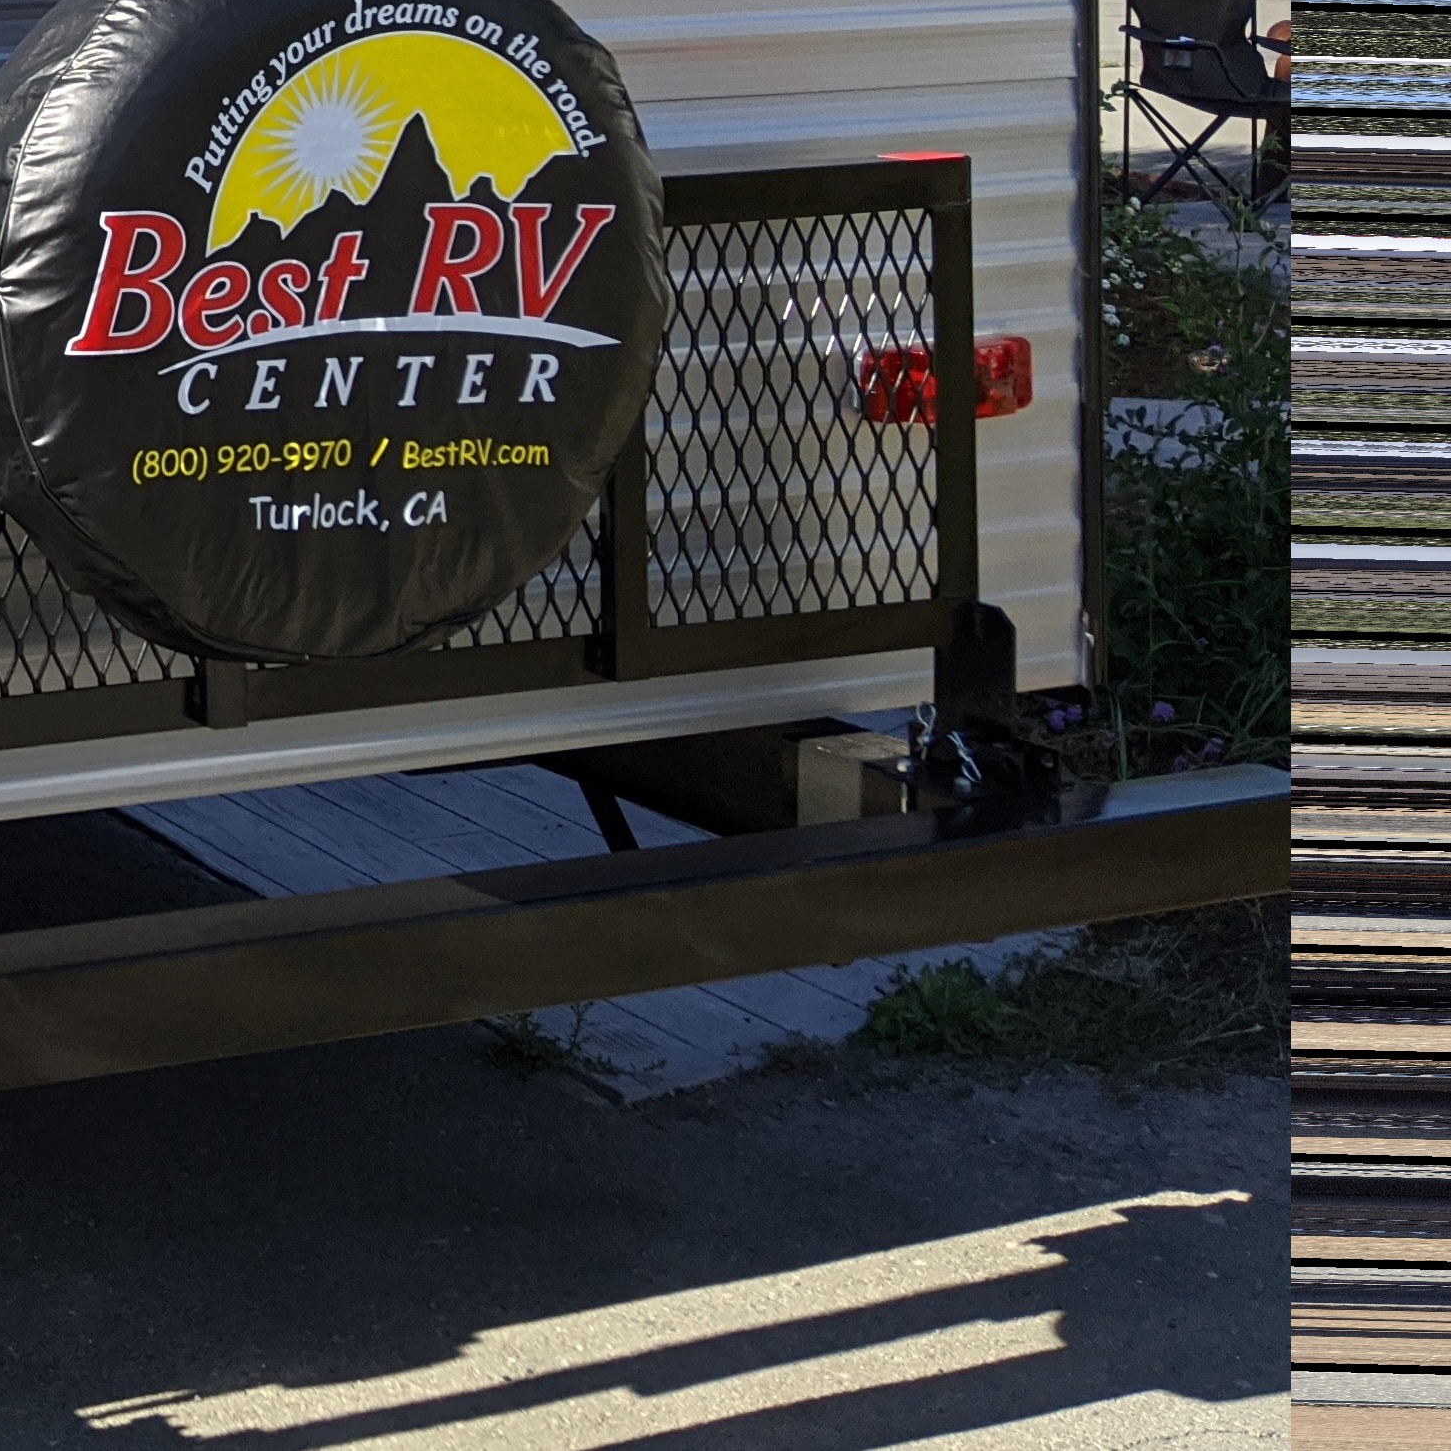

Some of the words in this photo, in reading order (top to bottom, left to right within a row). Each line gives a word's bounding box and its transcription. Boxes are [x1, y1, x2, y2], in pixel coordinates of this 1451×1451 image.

[184, 69, 273, 194] Putting
[269, 20, 336, 86] your
[464, 14, 504, 46] on
[506, 33, 551, 80] the
[546, 78, 607, 158] road.
[64, 210, 369, 356] Best
[408, 203, 616, 321] RV
[177, 353, 560, 415] CENTER
[132, 446, 208, 485] (800)
[217, 438, 352, 474] 920-9970
[368, 437, 390, 468] /
[402, 438, 550, 470] BestRV.com
[248, 489, 390, 533] Turlock,
[403, 490, 448, 528] CA
